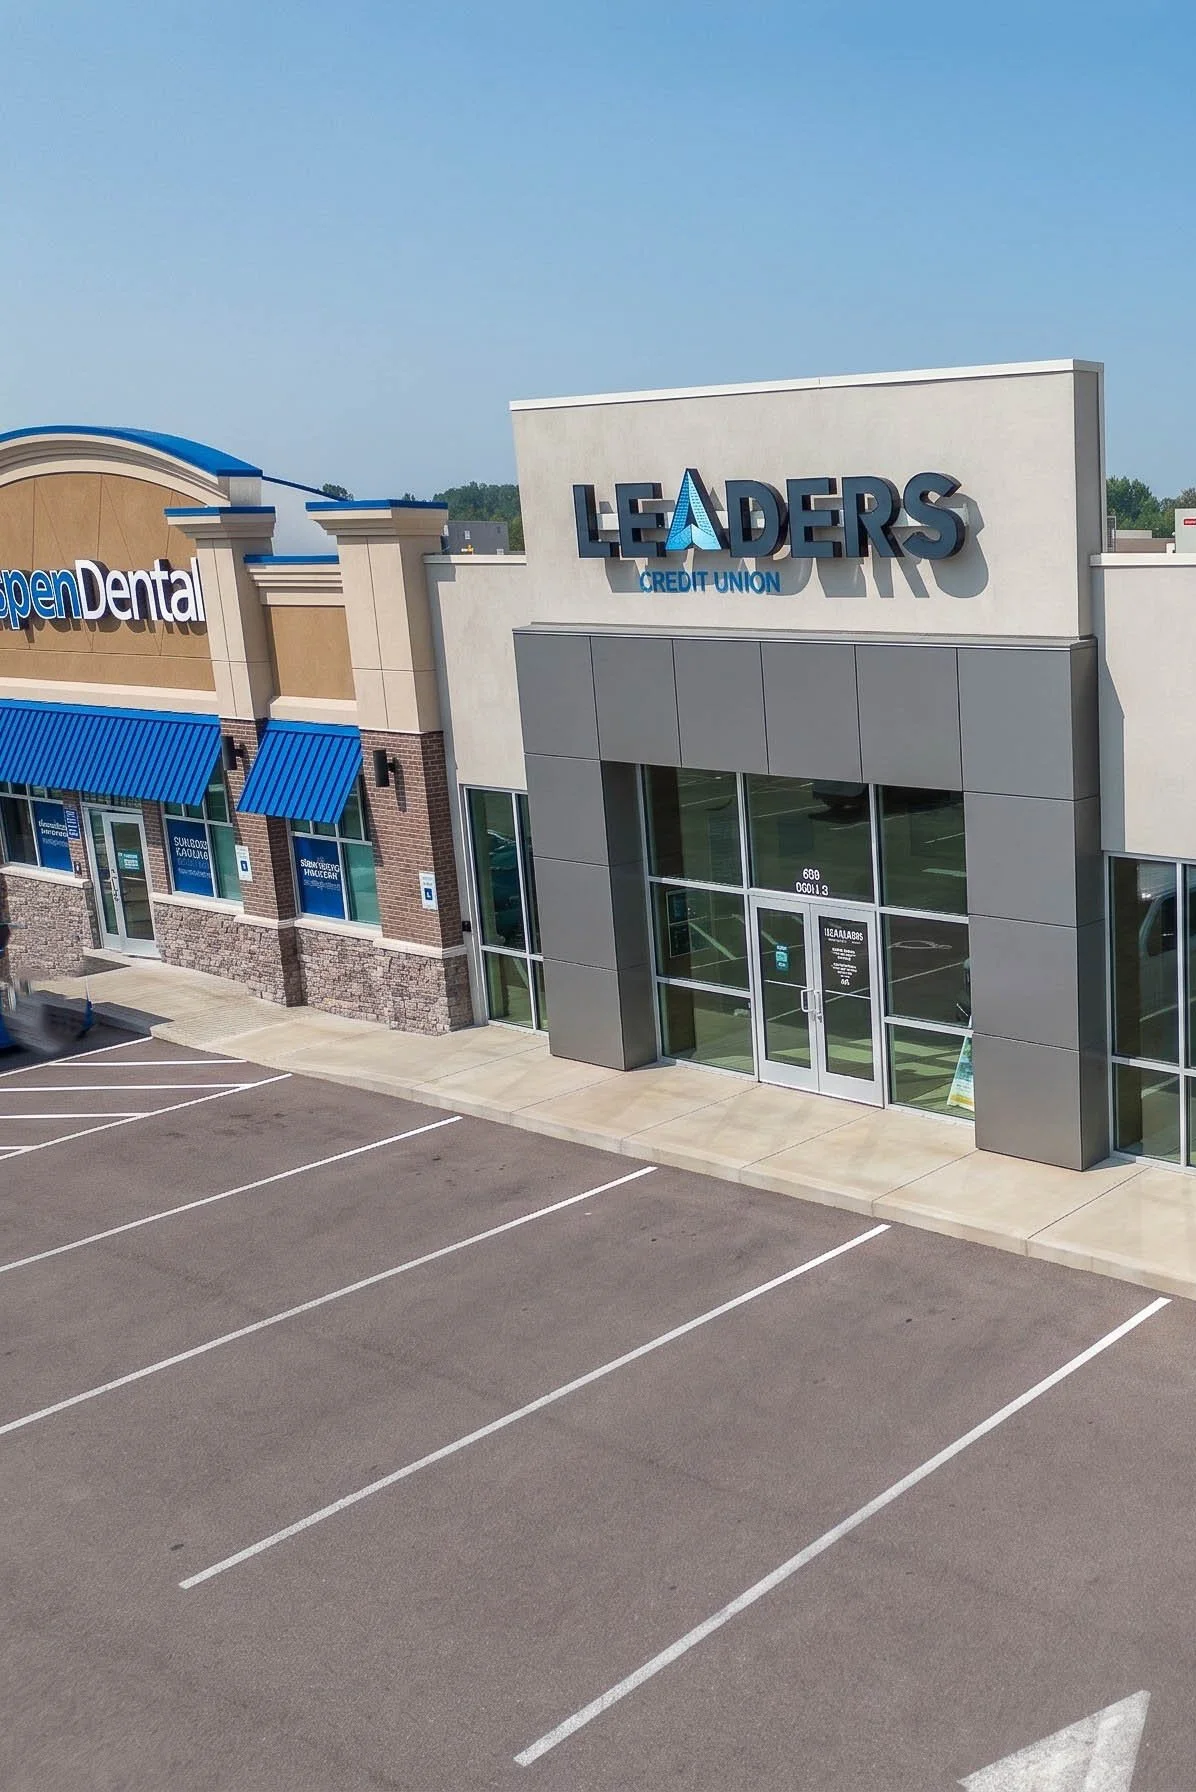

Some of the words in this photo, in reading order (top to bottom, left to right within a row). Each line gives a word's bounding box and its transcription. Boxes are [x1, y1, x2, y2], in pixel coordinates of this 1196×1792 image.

[572, 467, 965, 560] LEADERS
[639, 571, 708, 594] CREDIT
[713, 571, 781, 594] UNION
